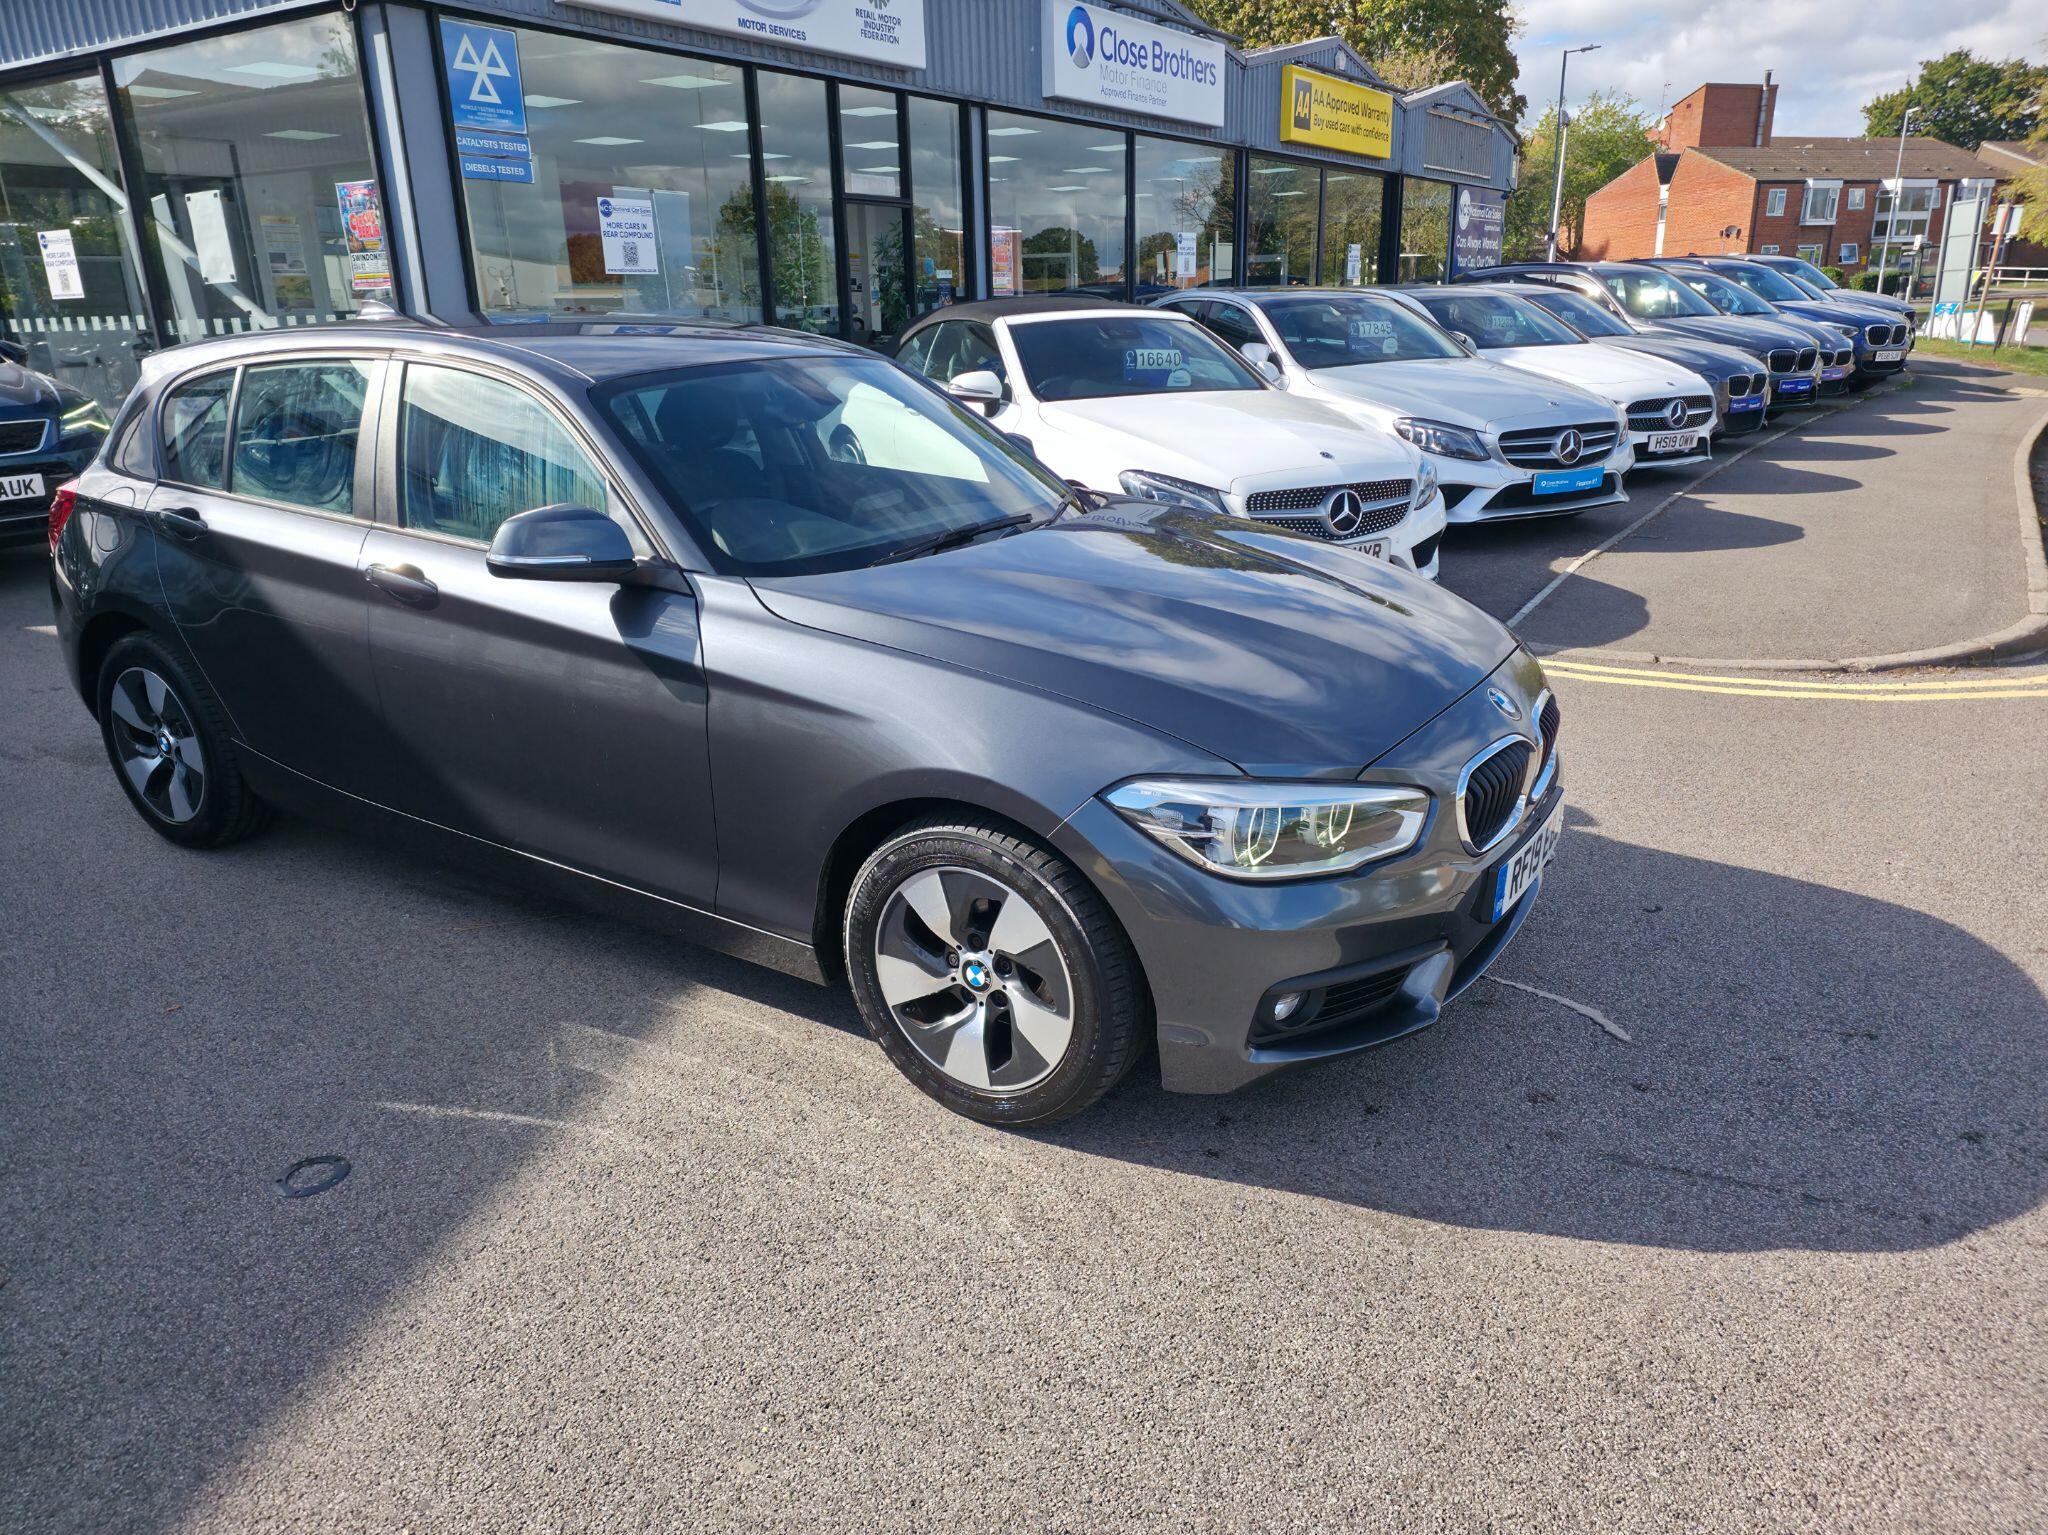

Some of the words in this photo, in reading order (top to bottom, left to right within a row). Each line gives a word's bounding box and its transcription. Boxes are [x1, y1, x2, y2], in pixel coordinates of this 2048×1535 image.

[855, 7, 877, 21] RETAIL
[877, 13, 902, 26] MOTOR
[737, 17, 767, 33] MOTOR
[768, 23, 807, 41] SERVICES
[860, 28, 900, 45] FEDERATION
[863, 20, 896, 35] INDUSTRY
[1100, 26, 1148, 70] Close
[1152, 40, 1217, 86] Brothers
[1100, 63, 1128, 86] Motor
[1130, 70, 1167, 94] Finance
[1100, 84, 1127, 100] Approved
[1127, 90, 1149, 104] Finance
[1149, 94, 1167, 107] Partner
[1296, 90, 1310, 119] AA
[1313, 89, 1325, 106] AA
[1326, 92, 1360, 115] Approved
[1361, 102, 1391, 127] Warranty
[1313, 113, 1325, 130] Buy
[1325, 117, 1339, 131] used
[1340, 120, 1350, 134] cars
[1351, 123, 1363, 137] with
[1363, 127, 1389, 143] confidence
[456, 136, 498, 150] CATALYSTS
[499, 141, 527, 152] TESTED
[465, 163, 496, 174] DIESELS
[497, 165, 525, 176] TESTED
[606, 222, 624, 230] MORE
[624, 222, 641, 230] CARS
[619, 231, 654, 239] COMPOUND
[1456, 234, 1467, 248] Cars
[1467, 235, 1482, 252] Always
[351, 253, 378, 262] SWINDON
[1457, 254, 1468, 268] Your
[1476, 255, 1485, 267] Our
[1654, 436, 1677, 450] HS19
[0, 478, 37, 499] AUK
